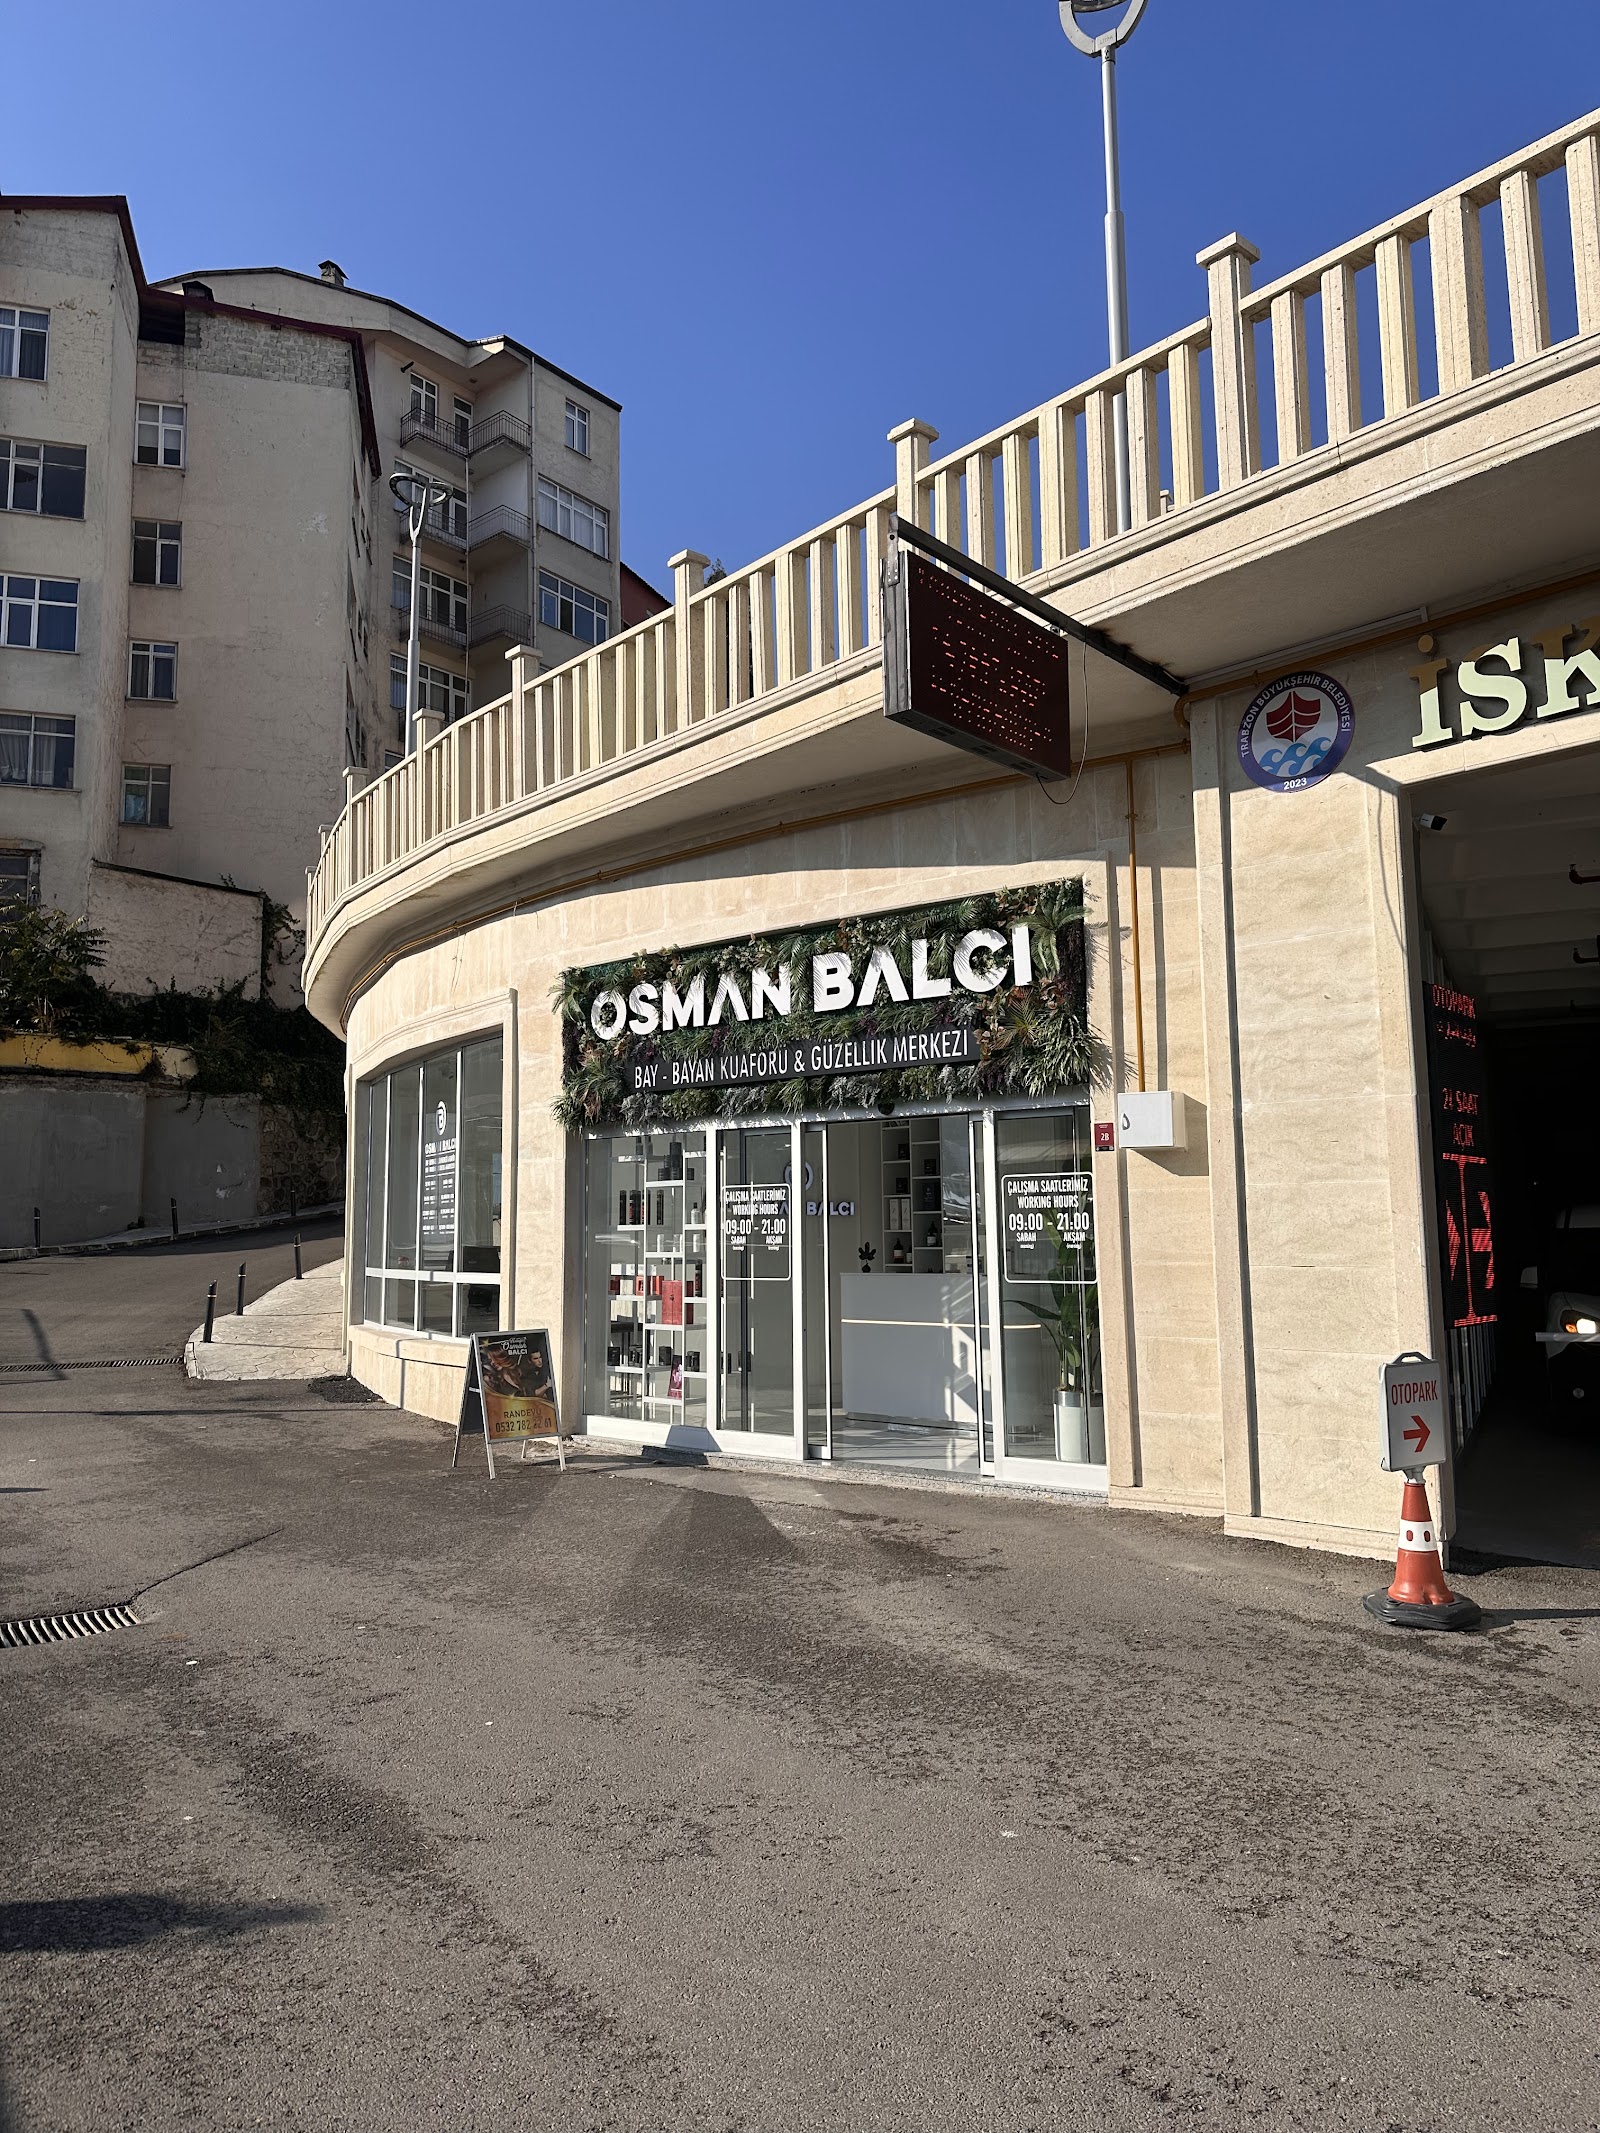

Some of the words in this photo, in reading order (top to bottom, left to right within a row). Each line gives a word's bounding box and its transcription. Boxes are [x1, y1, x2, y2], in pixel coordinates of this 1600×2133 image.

[1240, 706, 1259, 758] TRABZON
[1256, 674, 1321, 707] BÜYÜKŞEHİR
[1283, 777, 1307, 791] 2023
[591, 961, 791, 1041] OSMAN
[812, 924, 1033, 1012] BALCI
[634, 1063, 658, 1089] BAY
[672, 1058, 714, 1085] BAYAN
[793, 1050, 805, 1073] &
[1007, 1180, 1039, 1196] ÇALIŞMA
[1040, 1176, 1088, 1193] SAATLERİMİZ
[759, 1203, 779, 1215] HOURS
[1017, 1195, 1052, 1209] WORKING
[1053, 1194, 1079, 1208] HOURS
[761, 1218, 786, 1235] 21:00
[1008, 1212, 1043, 1231] 09:00
[1056, 1212, 1089, 1231] 21:00
[1016, 1232, 1037, 1242] SABAH
[1063, 1231, 1086, 1243] AKŞAM
[1391, 1379, 1438, 1406] OTOPARK
[503, 1408, 542, 1419] RANDEVU
[496, 1421, 515, 1433] 0532
[516, 1419, 531, 1431] 782
